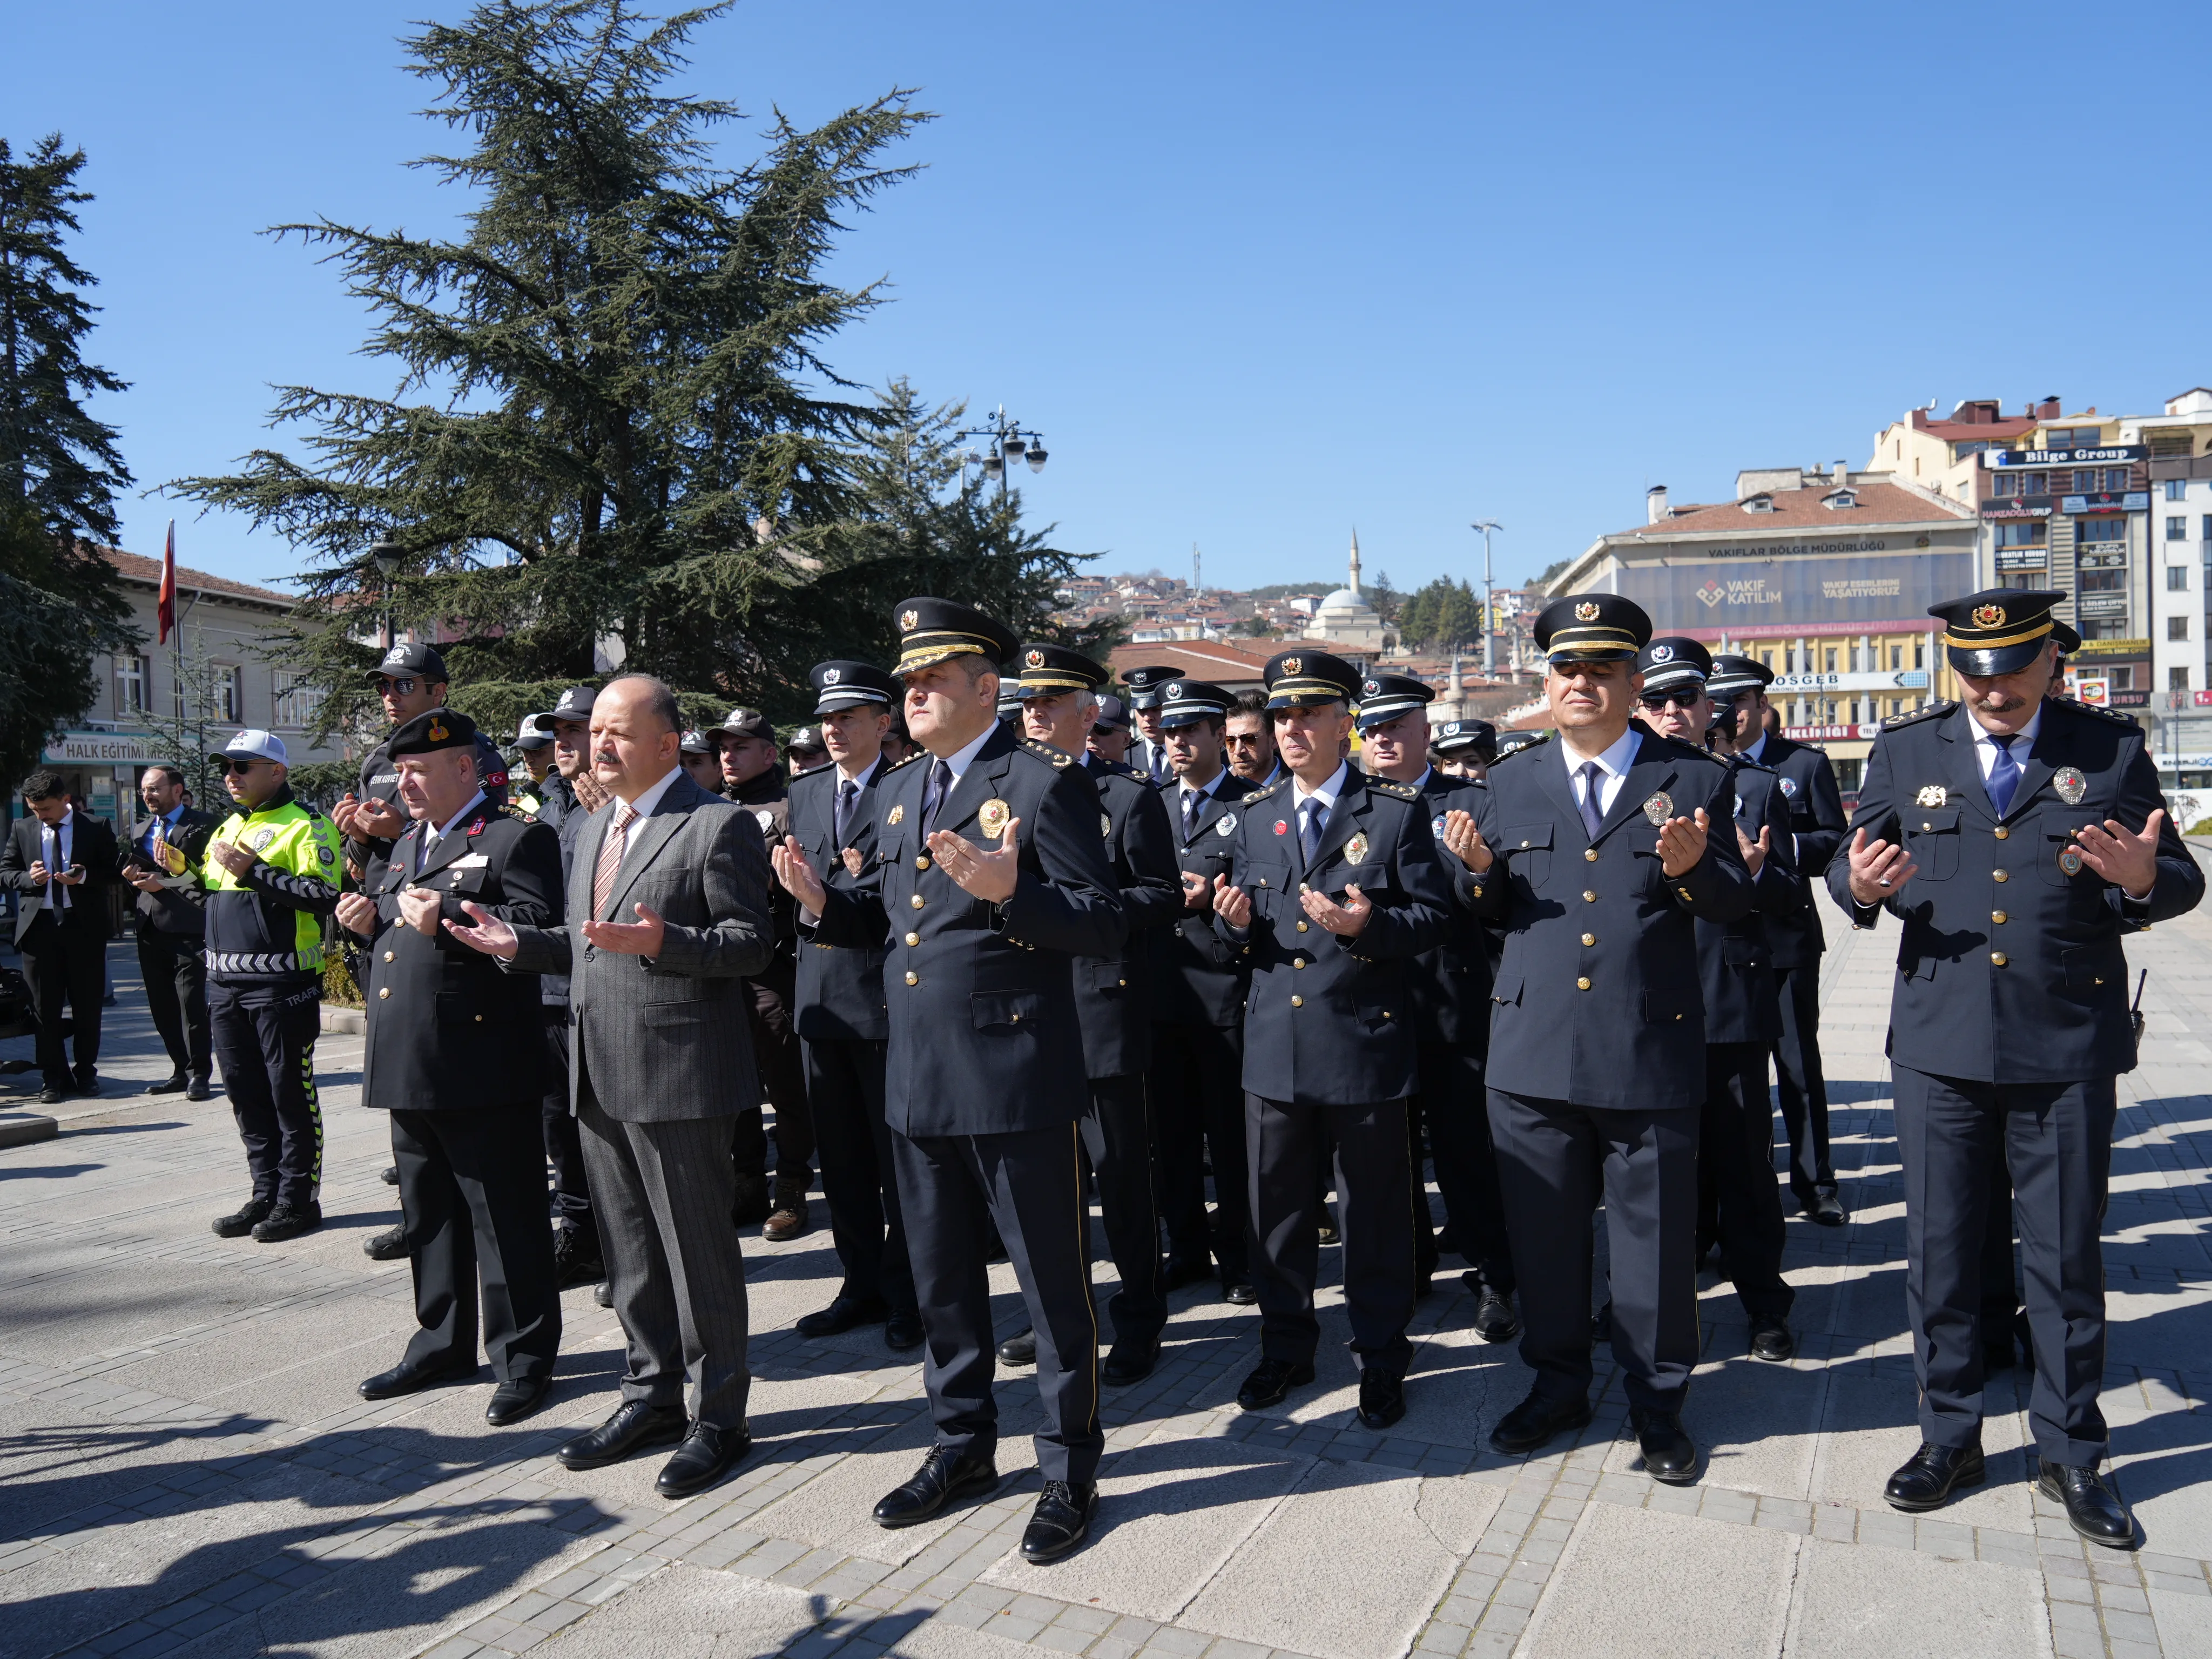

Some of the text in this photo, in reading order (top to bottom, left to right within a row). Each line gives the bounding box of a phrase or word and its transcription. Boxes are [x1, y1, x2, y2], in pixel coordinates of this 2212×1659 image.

[2026, 448, 2128, 463] Bilge Group
[1709, 540, 1885, 558] VAKIFLAR BÖLGE MÜDÜRLÜĞÜ
[1727, 579, 1765, 592] VAKIF
[1822, 578, 1900, 589] VAKIF ESERLERİNİ
[1728, 591, 1782, 604] KATILIM
[1823, 587, 1900, 599] YAŞATIYORUZ
[1771, 675, 1838, 685] OSGEB
[66, 744, 99, 758] HALK
[102, 742, 144, 759] EĞİTİMİ
